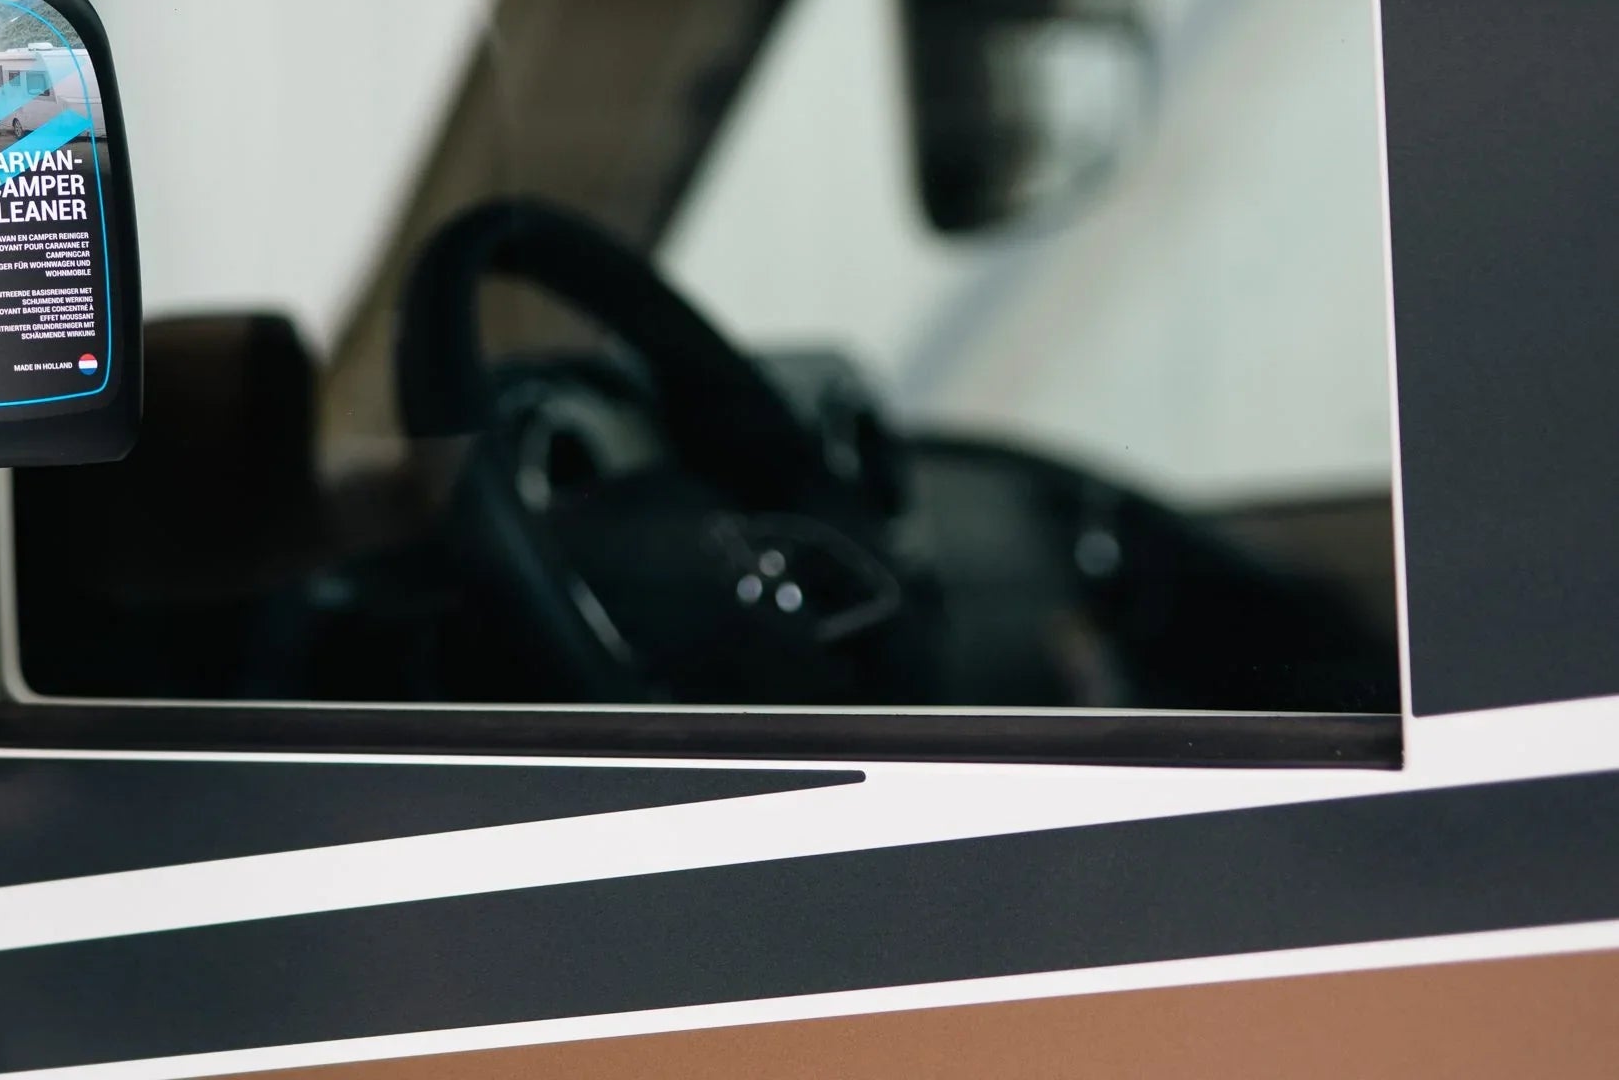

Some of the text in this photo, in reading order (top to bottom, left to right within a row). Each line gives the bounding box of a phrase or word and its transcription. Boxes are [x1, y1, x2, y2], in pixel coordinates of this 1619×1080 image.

[28, 233, 58, 241] CAMPER
[58, 232, 89, 240] REINIGER
[24, 243, 44, 251] POUR
[44, 241, 80, 250] CARAVANE
[45, 250, 90, 259] CAMPINGCAR
[14, 261, 29, 270] FÜR
[29, 260, 75, 269] WOHNWAGEN
[76, 259, 91, 267] UND
[45, 269, 91, 277] WOHNMOBILE
[31, 288, 79, 297] BASISREINIGER
[22, 297, 64, 305] SCHUIMENDE
[22, 306, 51, 314] BASIQUE
[51, 303, 88, 312] CONCENTRÉ
[40, 312, 94, 322] EFFET MOUSSANT
[32, 322, 83, 331] GRUNDREINIGER
[66, 330, 96, 338] WIRKUNG
[42, 362, 73, 370] HOLLAND
